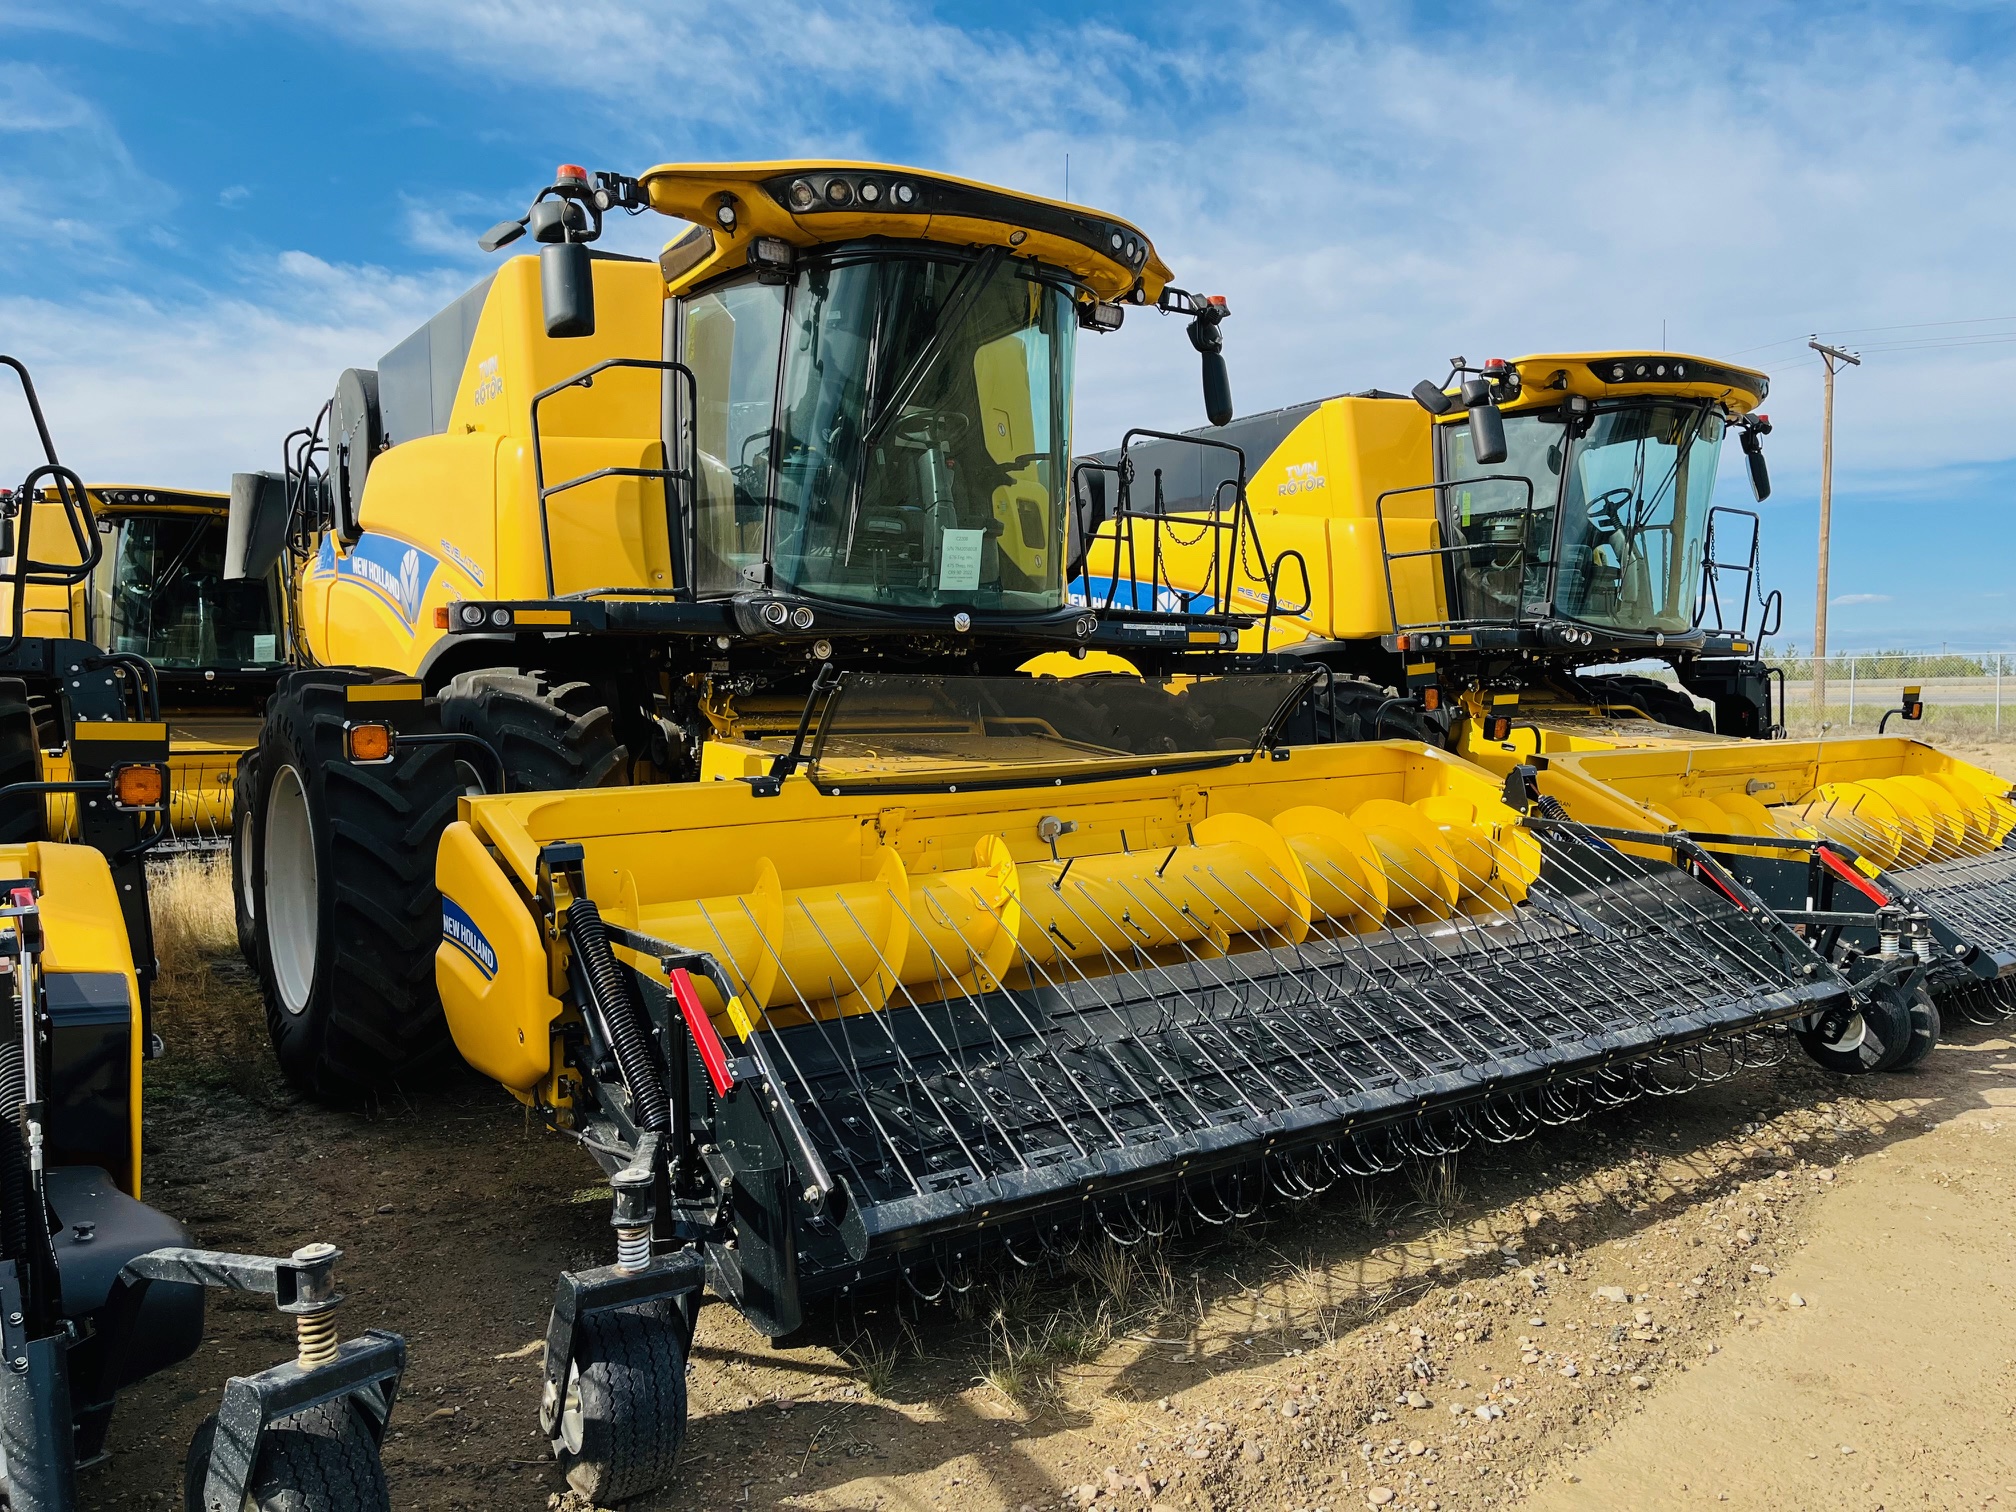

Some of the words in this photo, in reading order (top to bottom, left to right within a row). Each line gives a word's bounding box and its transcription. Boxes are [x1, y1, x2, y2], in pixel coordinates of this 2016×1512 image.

[474, 375, 503, 407] ROTOR
[1278, 474, 1326, 497] ROTOR
[1285, 460, 1318, 479] TWIN
[352, 555, 368, 578] NEW
[368, 560, 400, 601] HOLLAND
[440, 538, 485, 582] REVELATION
[443, 914, 460, 938] NEW
[461, 924, 493, 969] HOLLAND
